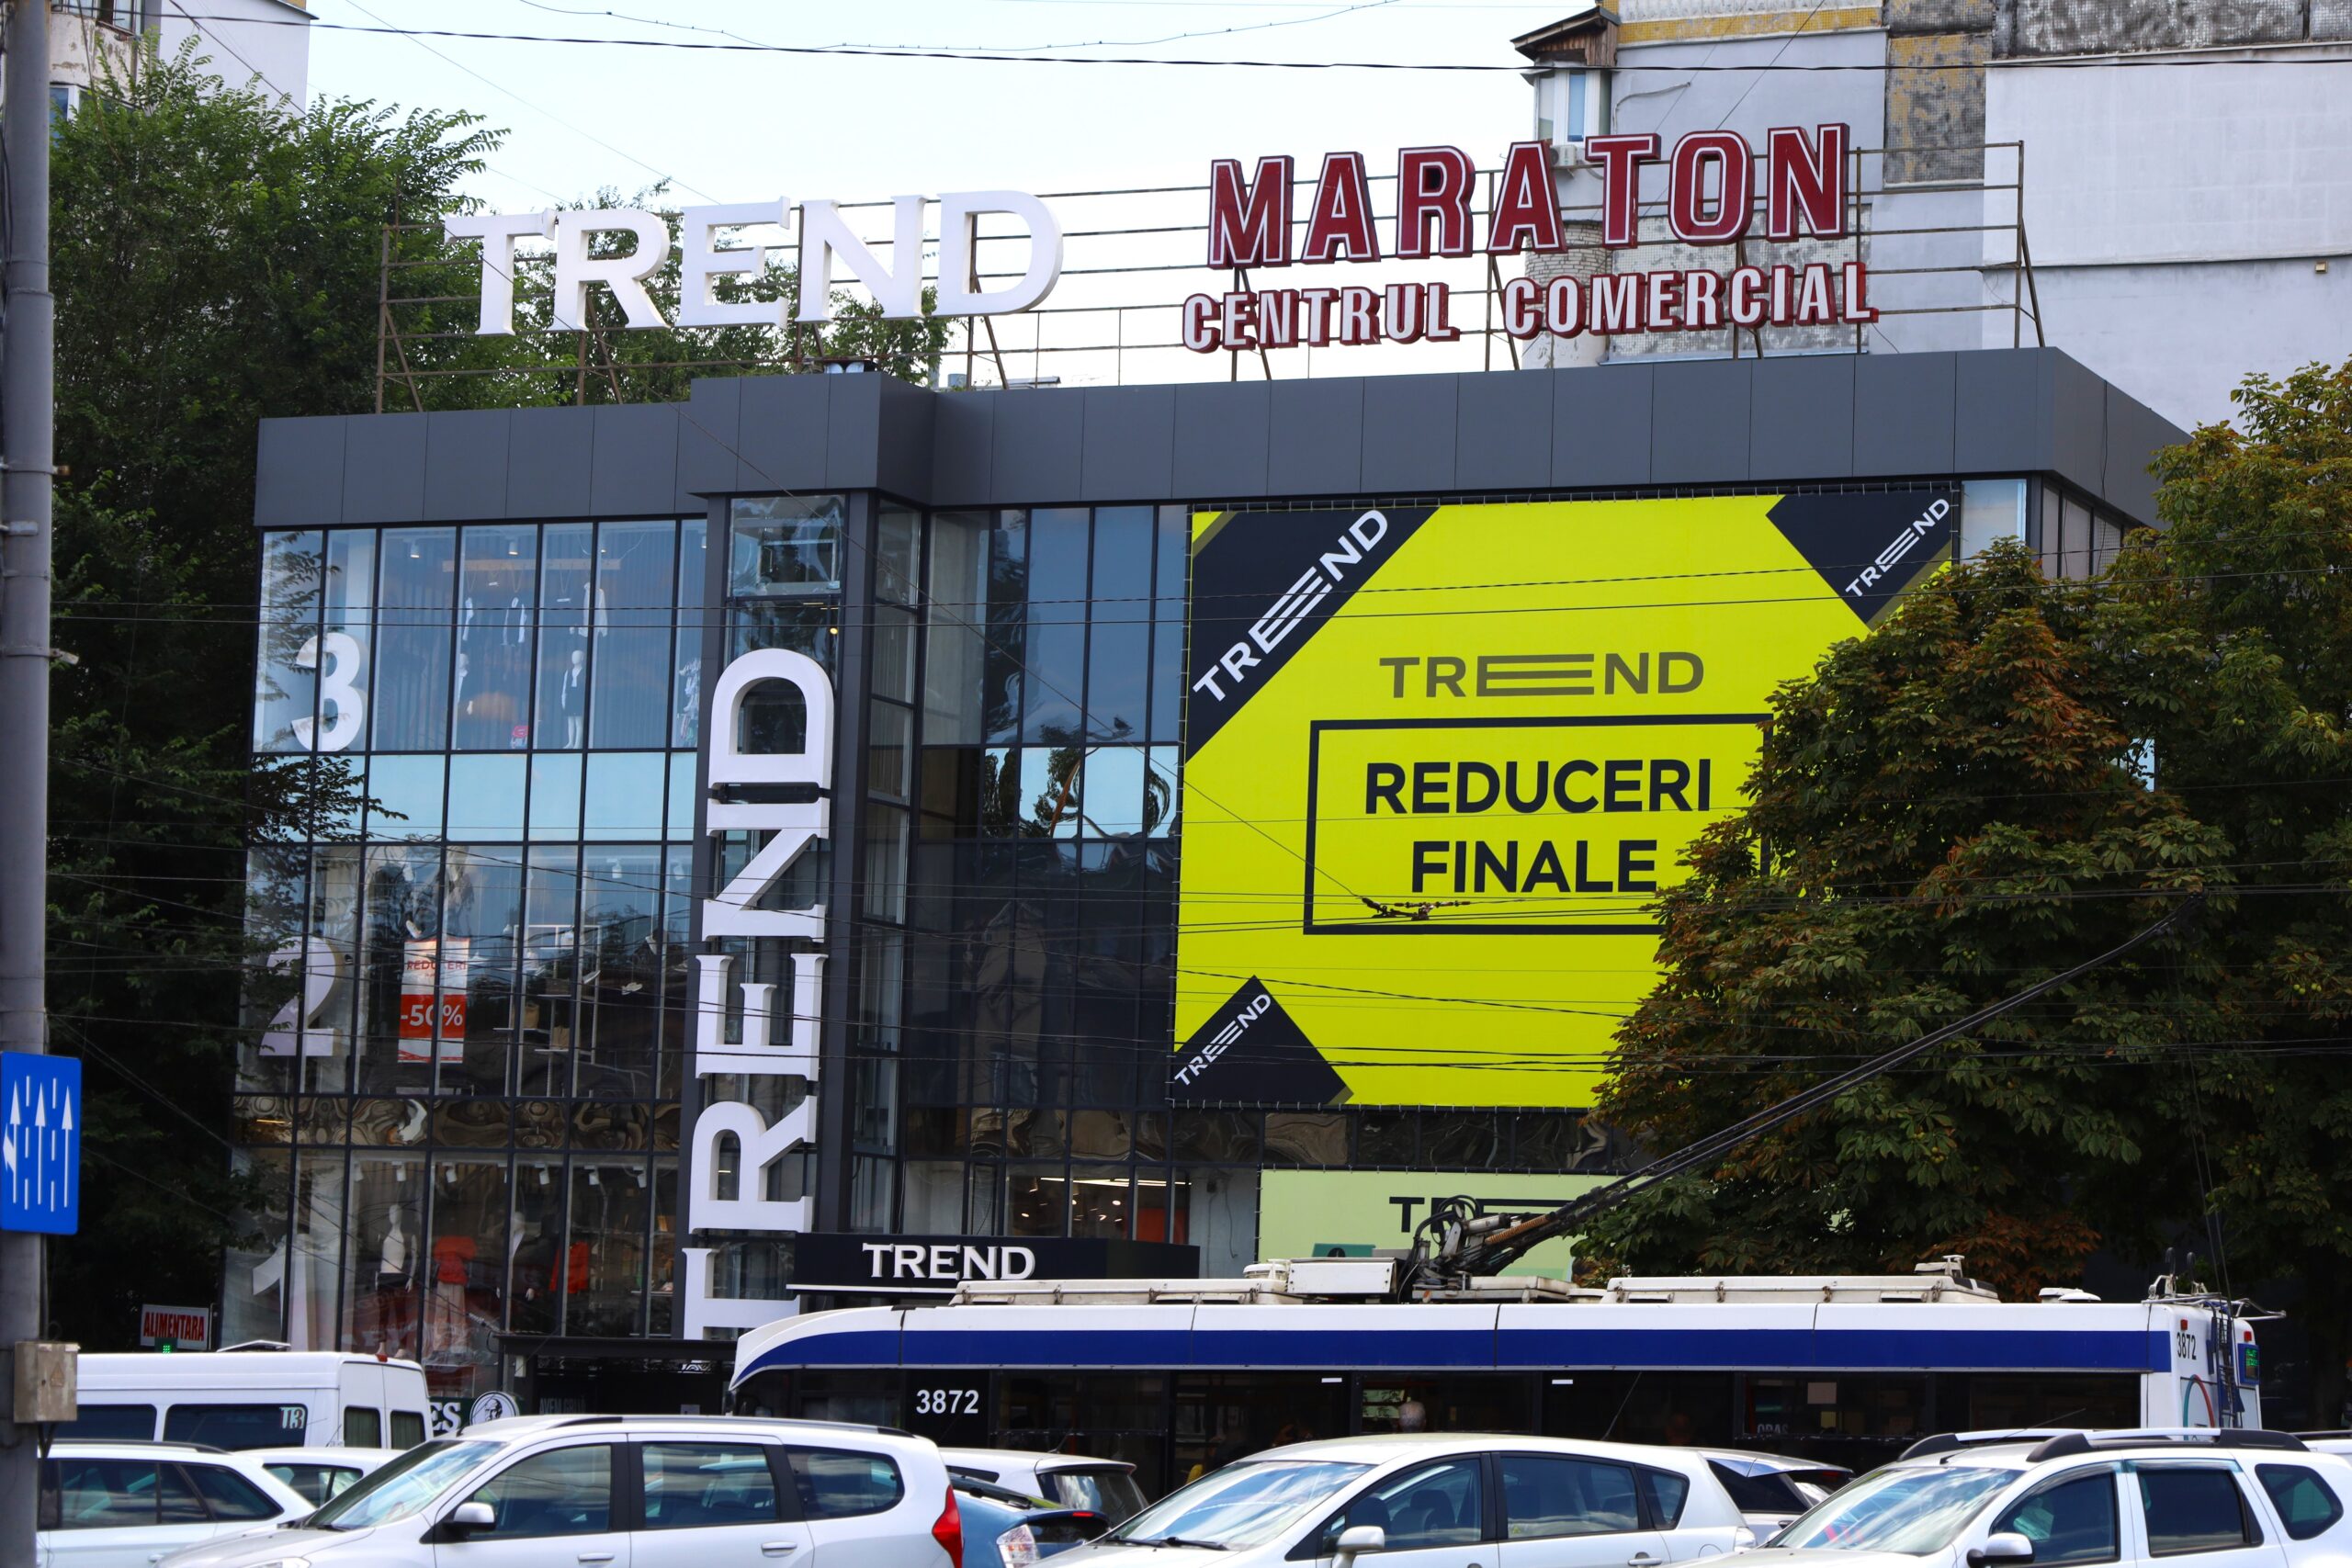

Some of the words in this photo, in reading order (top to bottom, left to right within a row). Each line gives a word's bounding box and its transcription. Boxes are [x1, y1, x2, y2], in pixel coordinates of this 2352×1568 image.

[1207, 123, 1849, 269] MARATON
[444, 190, 1064, 336] TREND
[1182, 282, 1461, 354] CENTRUL
[1504, 261, 1880, 339] COMERCIAL
[1845, 498, 1950, 597] TREND
[1193, 509, 1388, 702] TREND
[290, 632, 364, 752] 3
[1379, 650, 1705, 698] TREND
[1365, 759, 1712, 815] REDUCERI
[1411, 840, 1657, 894] FINALE
[406, 960, 467, 970] REDUERI
[683, 648, 834, 1340] TREND
[1174, 994, 1272, 1086] TREND
[862, 1242, 1035, 1280] TREND
[143, 1312, 205, 1342] ALIMENTARA
[2177, 1332, 2197, 1360] 3872
[916, 1389, 979, 1415] 3872
